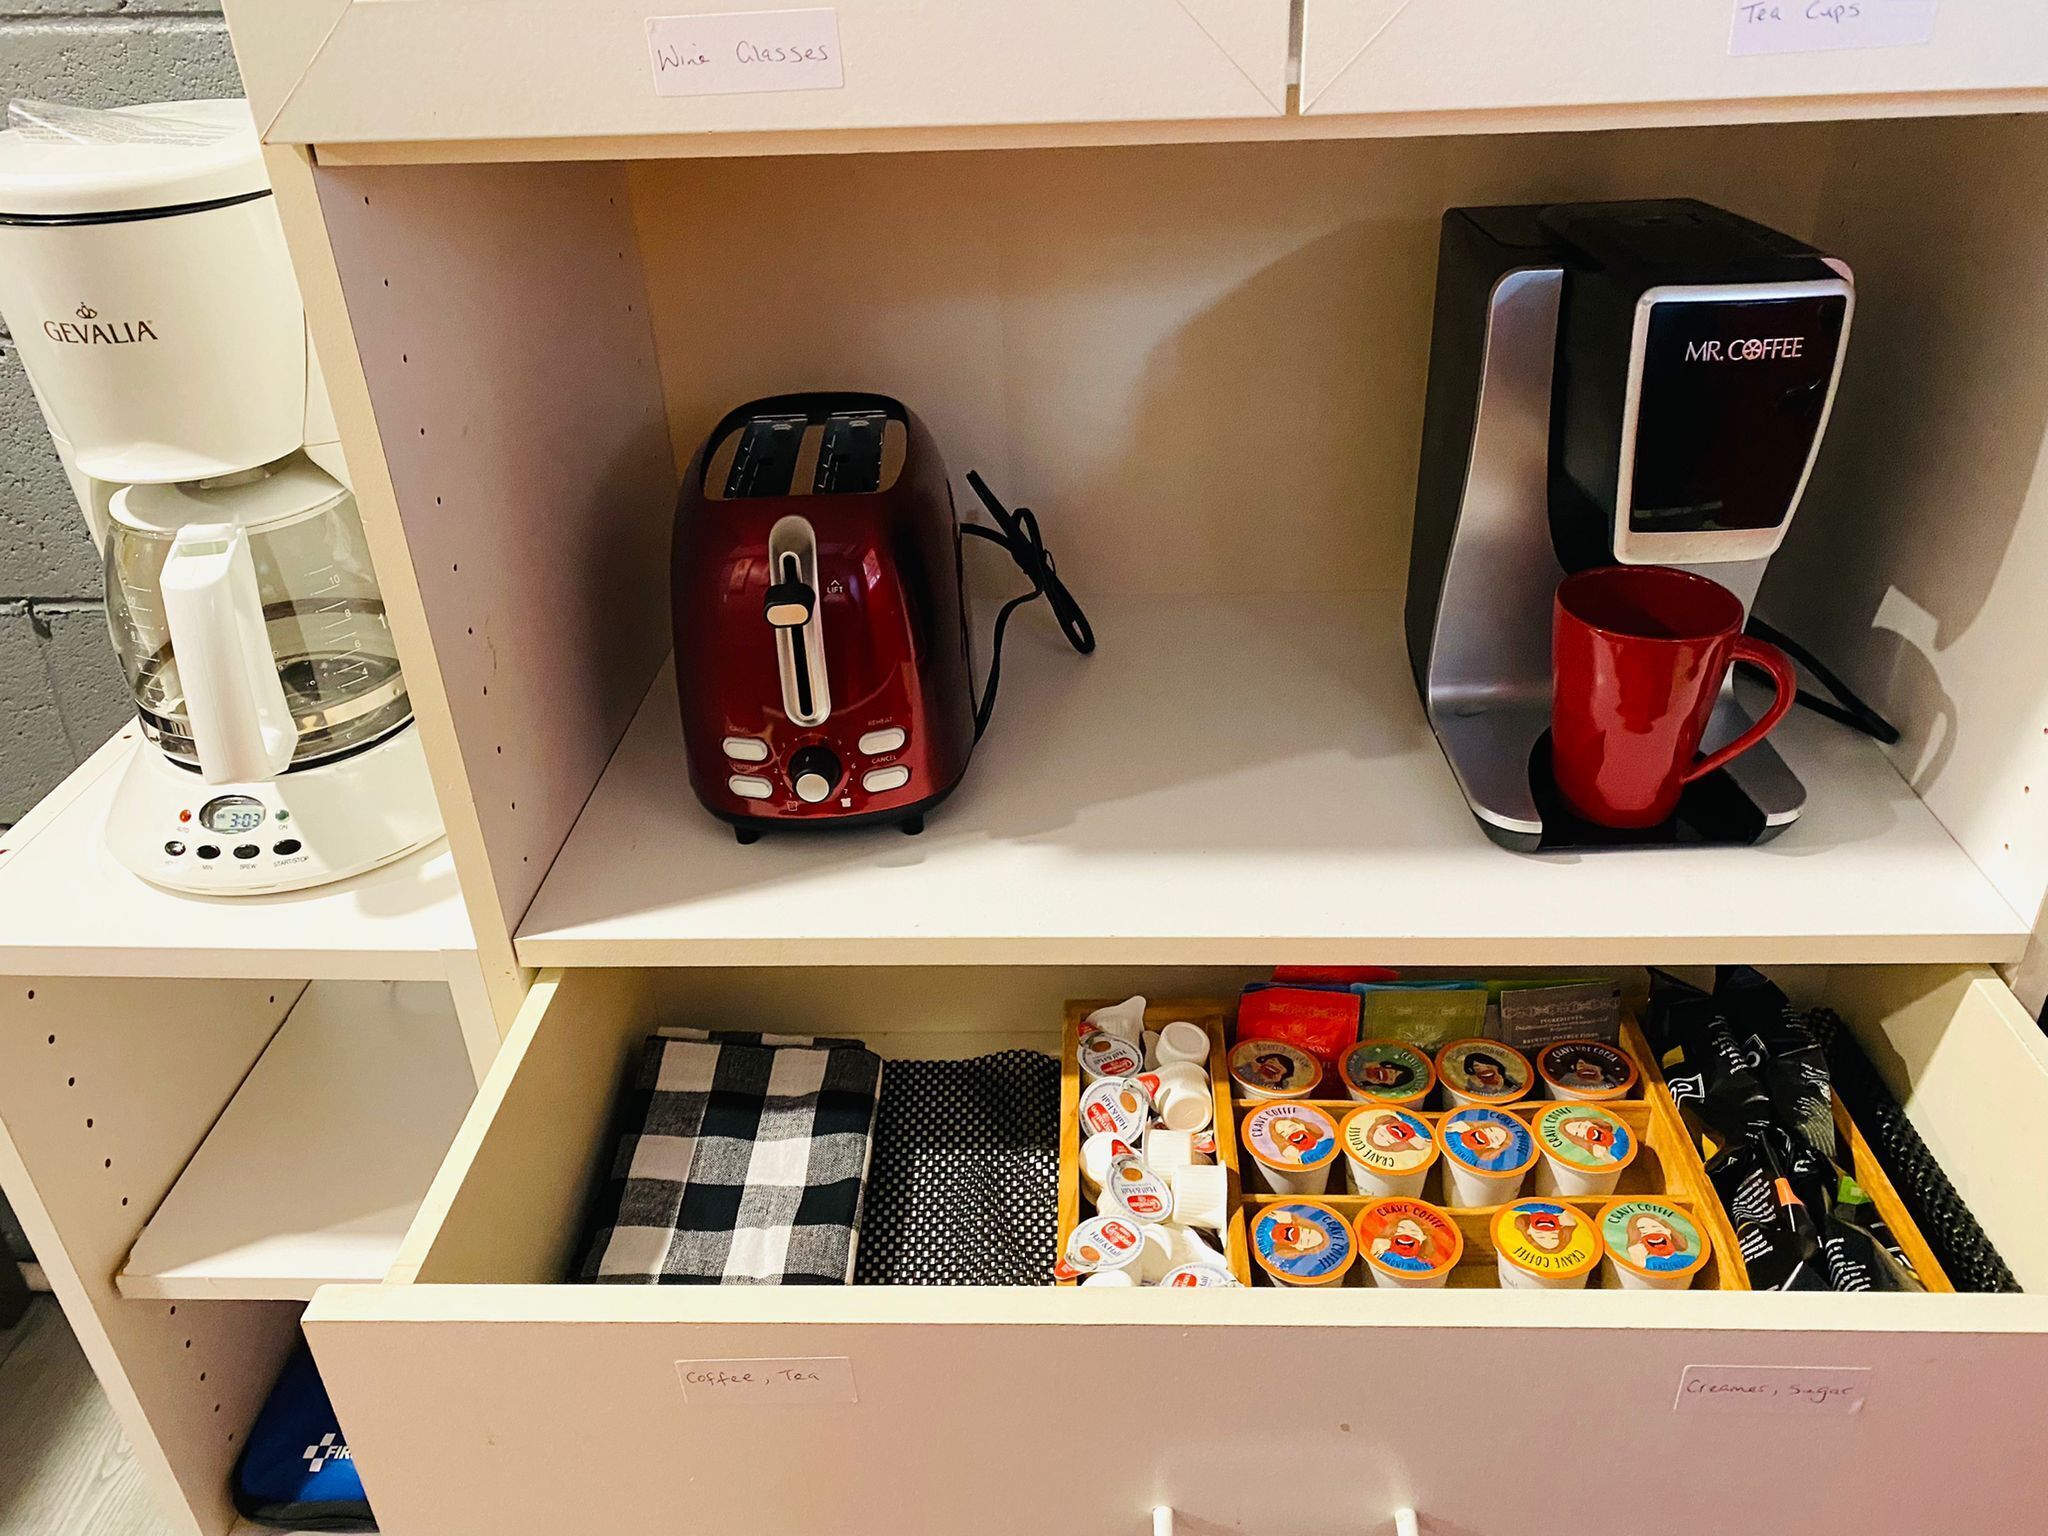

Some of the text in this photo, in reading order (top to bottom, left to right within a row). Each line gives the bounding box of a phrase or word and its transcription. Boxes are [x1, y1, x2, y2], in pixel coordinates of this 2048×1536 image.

[1740, 0, 1860, 24] Tea Cups
[657, 41, 829, 71] Wine Glasses
[42, 320, 158, 344] GEVALIA
[1685, 337, 1805, 361] MR. COFFEE
[329, 574, 340, 585] 10
[826, 586, 844, 594] LIFT
[871, 755, 897, 764] CANCEL
[229, 812, 261, 828] 3:03
[1252, 1106, 1297, 1138] CRAVE COFFEE
[1545, 1123, 1563, 1149] CRAVE
[1363, 1147, 1395, 1168] CRAVE
[1376, 1204, 1447, 1230] CRAVE COFFEE
[1607, 1202, 1676, 1225] CRAVE COFFEE
[1318, 1216, 1345, 1270] CRAVE COFFEE
[1513, 1245, 1586, 1269] CRAVE COFFEE
[778, 1369, 821, 1382] Tea
[324, 1445, 353, 1460] FIR
